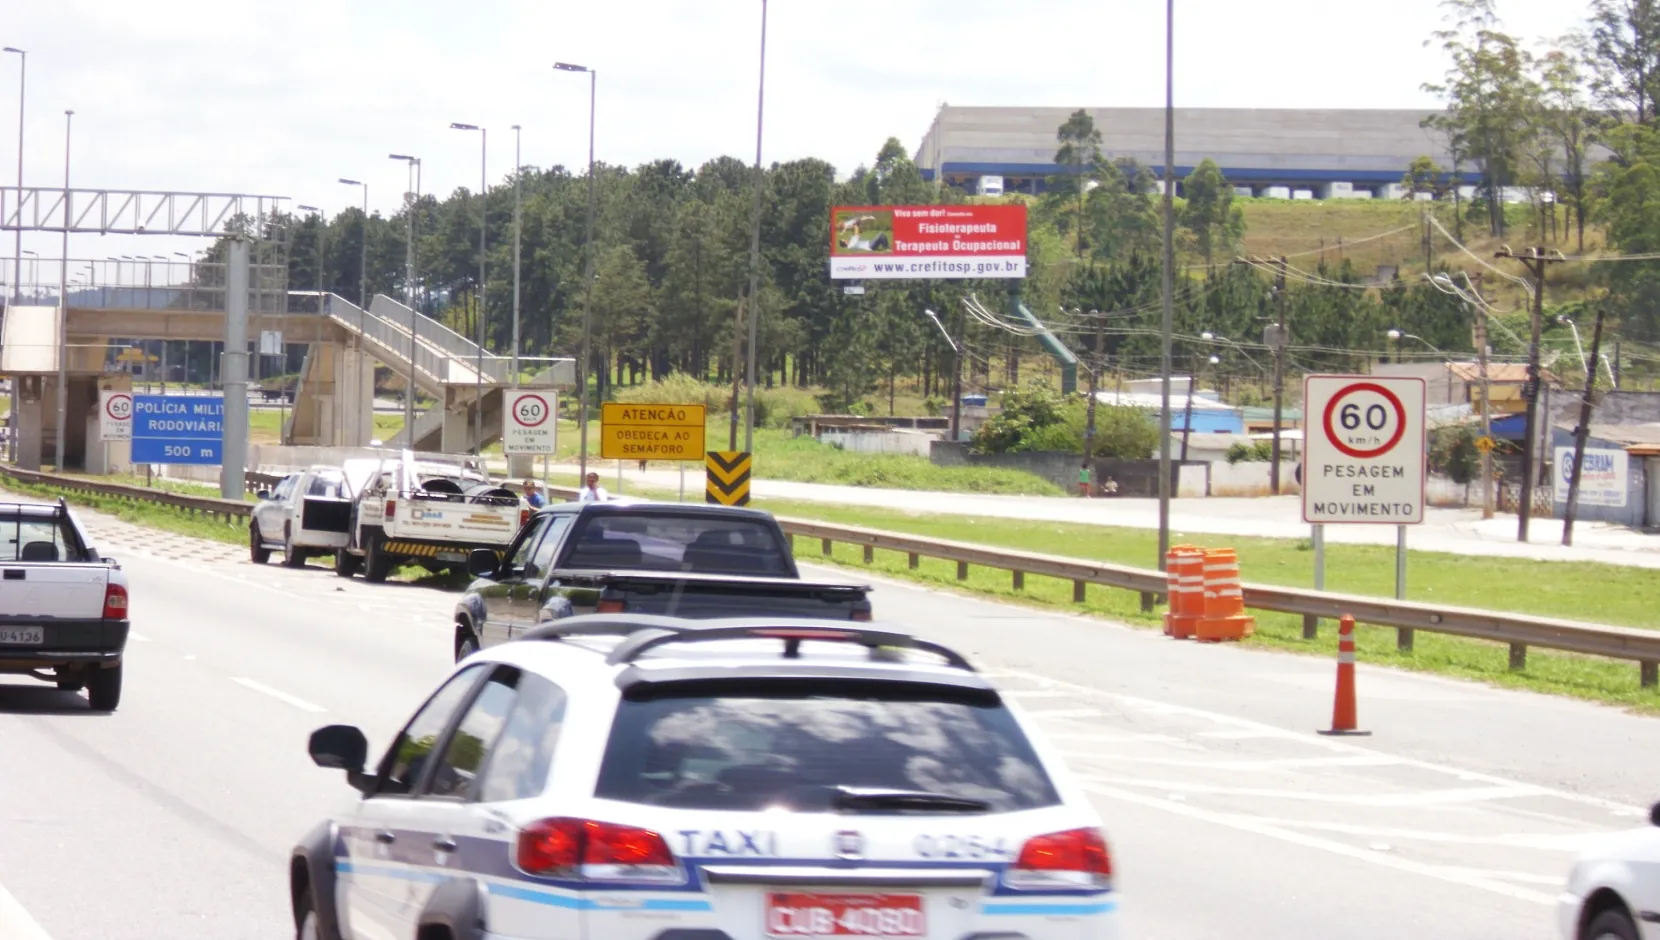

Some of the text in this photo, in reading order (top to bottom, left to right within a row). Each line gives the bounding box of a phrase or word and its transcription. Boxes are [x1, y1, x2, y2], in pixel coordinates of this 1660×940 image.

[894, 209, 911, 217] Viva
[930, 209, 946, 217] dor!
[918, 223, 997, 235] Fisioterapeuta
[895, 240, 1021, 253] Terapeuta Ocupacional
[874, 261, 1018, 274] www.crefitosp.gov.br
[112, 402, 129, 413] 60
[135, 400, 224, 416] POLÍCIA MILIT
[520, 404, 540, 417] 60
[622, 408, 686, 422] ATENÇÃO
[1340, 403, 1387, 431] 60
[148, 417, 224, 432] RODOVIÁRI
[616, 430, 690, 442] OBEDEÇA AO
[164, 445, 213, 458] 500 m
[622, 442, 684, 454] SEMÁFORO
[1323, 464, 1405, 479] PESAGEM
[1352, 484, 1376, 497] EM
[1313, 502, 1414, 516] MOVIMENTO
[677, 829, 781, 856] TAXI
